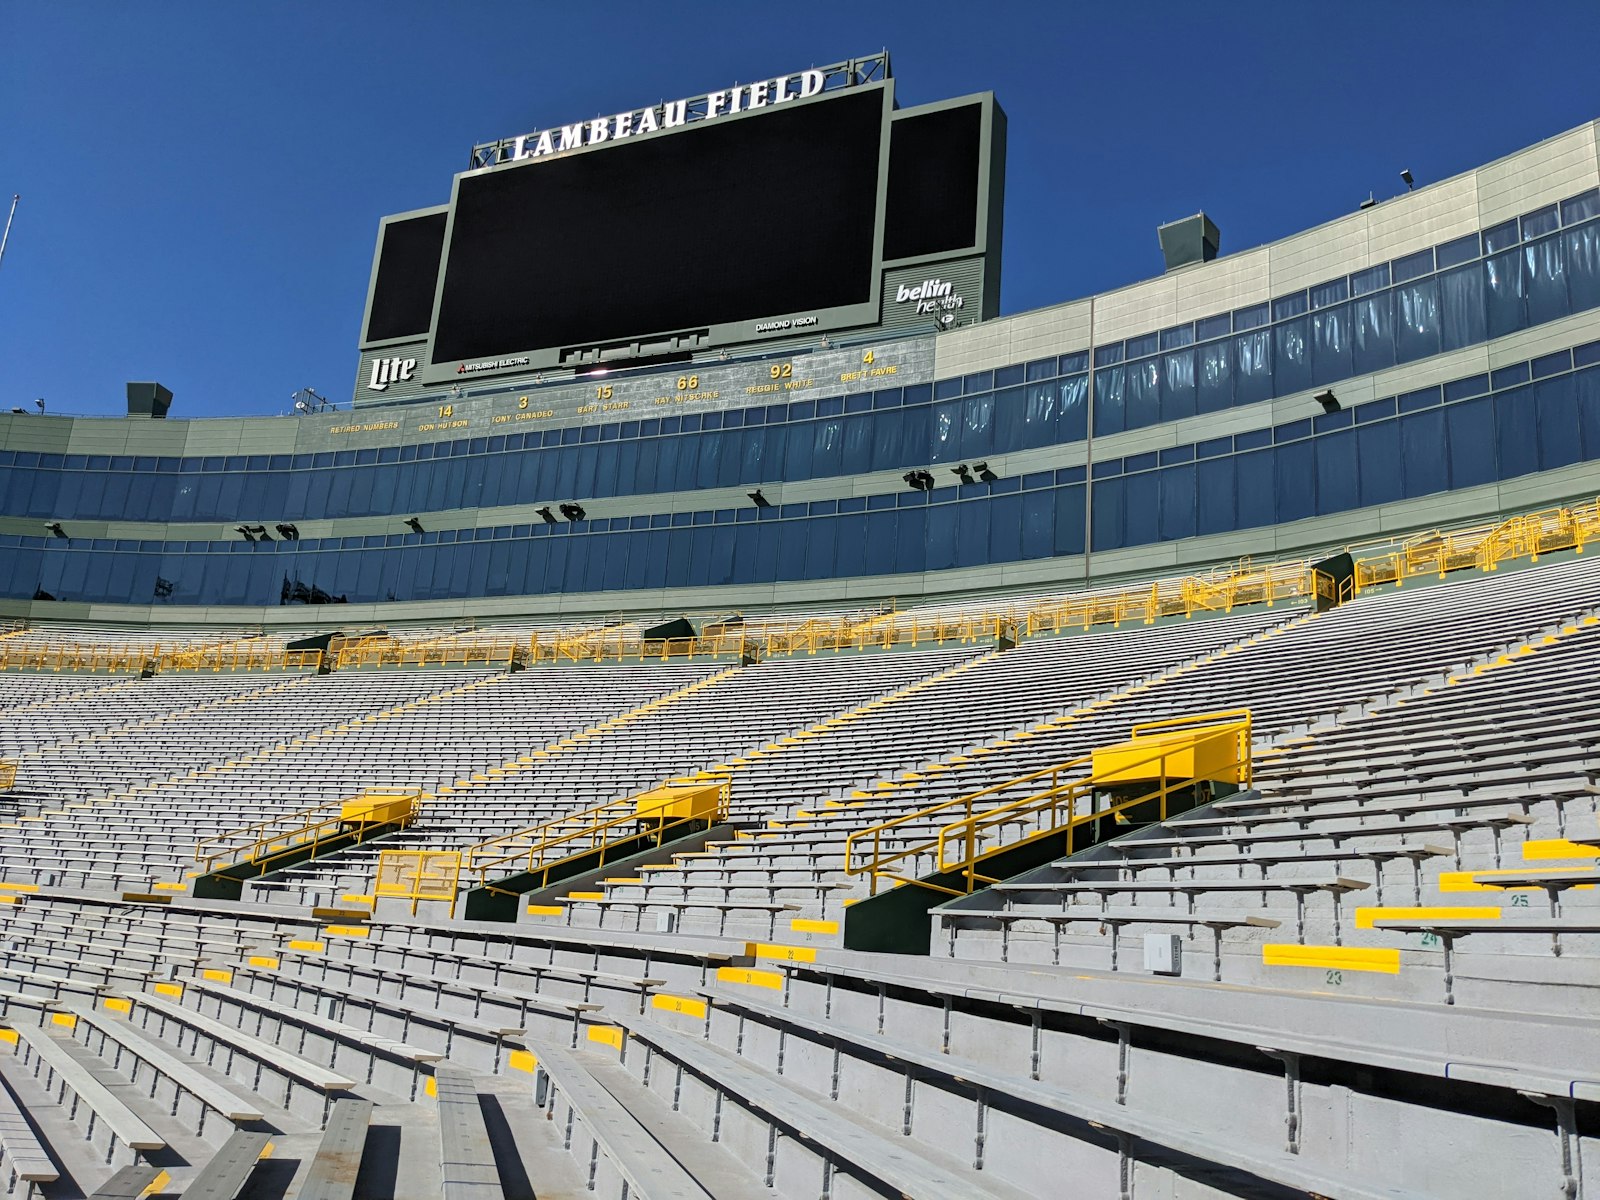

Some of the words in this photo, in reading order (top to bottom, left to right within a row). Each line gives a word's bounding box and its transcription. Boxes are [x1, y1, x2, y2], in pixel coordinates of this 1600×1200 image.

[512, 100, 688, 161] LAMBEAU
[705, 69, 827, 120] FIELD
[896, 279, 952, 302] bellin
[755, 319, 790, 332] DIAMOND
[792, 316, 817, 326] VISION
[465, 360, 499, 371] MITSUBISHI
[499, 356, 529, 367] ELECTRIC
[863, 350, 874, 364] 4
[367, 357, 416, 391] Lite
[770, 362, 793, 379] 92
[840, 370, 868, 382] BRETT
[870, 365, 898, 377] FAVRE
[677, 374, 699, 391] 66
[745, 382, 780, 394] REGGIE
[784, 378, 814, 390] WHITE
[596, 385, 613, 400] 15
[654, 396, 671, 405] RAY
[674, 390, 720, 403] NITSCHKE
[518, 396, 529, 409] 3
[577, 405, 599, 414] BART
[602, 401, 630, 411] STARR
[438, 404, 453, 418] 14
[491, 415, 511, 424] TONY
[515, 409, 554, 421] CANADEO
[330, 424, 361, 434] RETIRED
[363, 421, 399, 432] NUMBERS
[418, 424, 434, 433] DON
[437, 419, 468, 430] HUTSON
[1511, 894, 1529, 907] 25
[1326, 970, 1342, 986] 23
